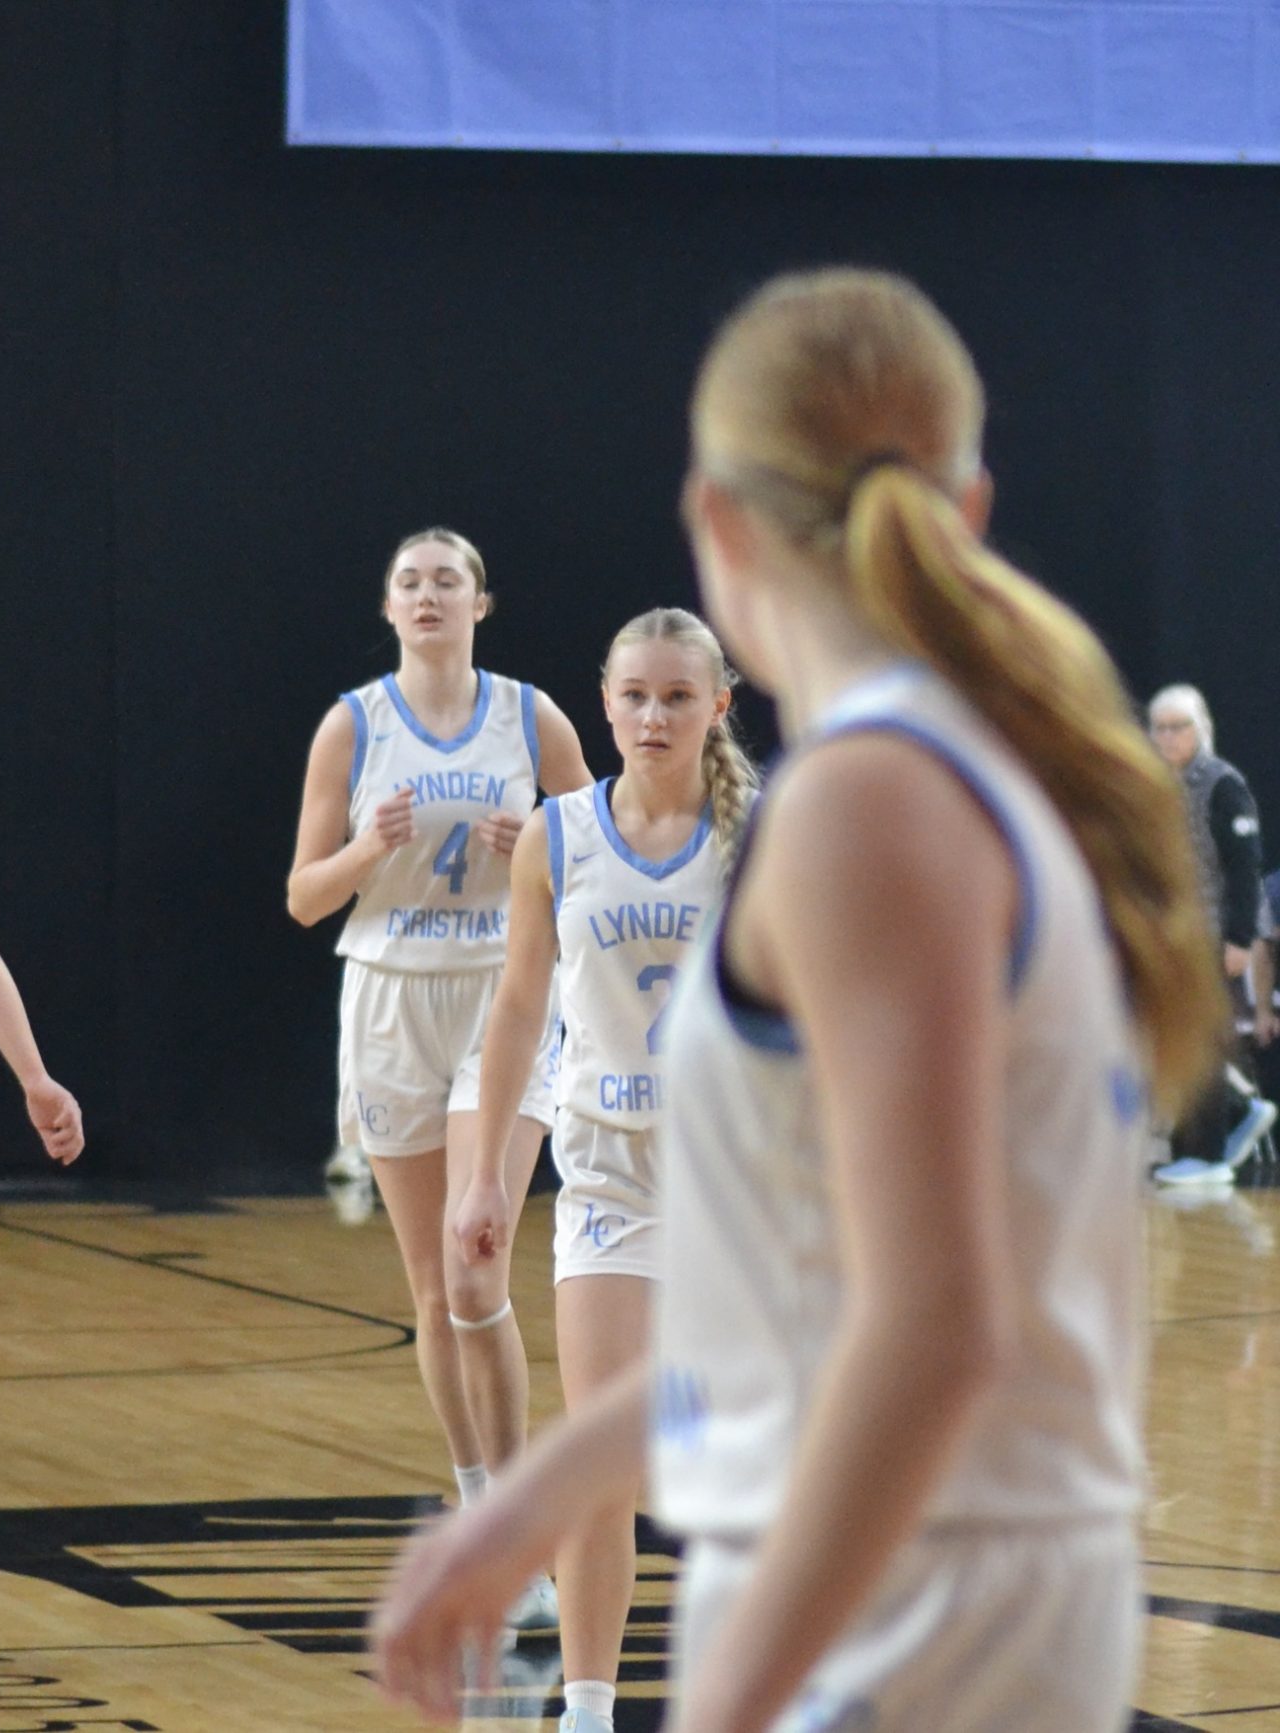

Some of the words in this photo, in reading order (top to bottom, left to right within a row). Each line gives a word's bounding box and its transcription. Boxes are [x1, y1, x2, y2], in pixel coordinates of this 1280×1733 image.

[394, 771, 506, 808] YNDEN
[433, 821, 469, 895] 4
[588, 902, 701, 950] LYNDE
